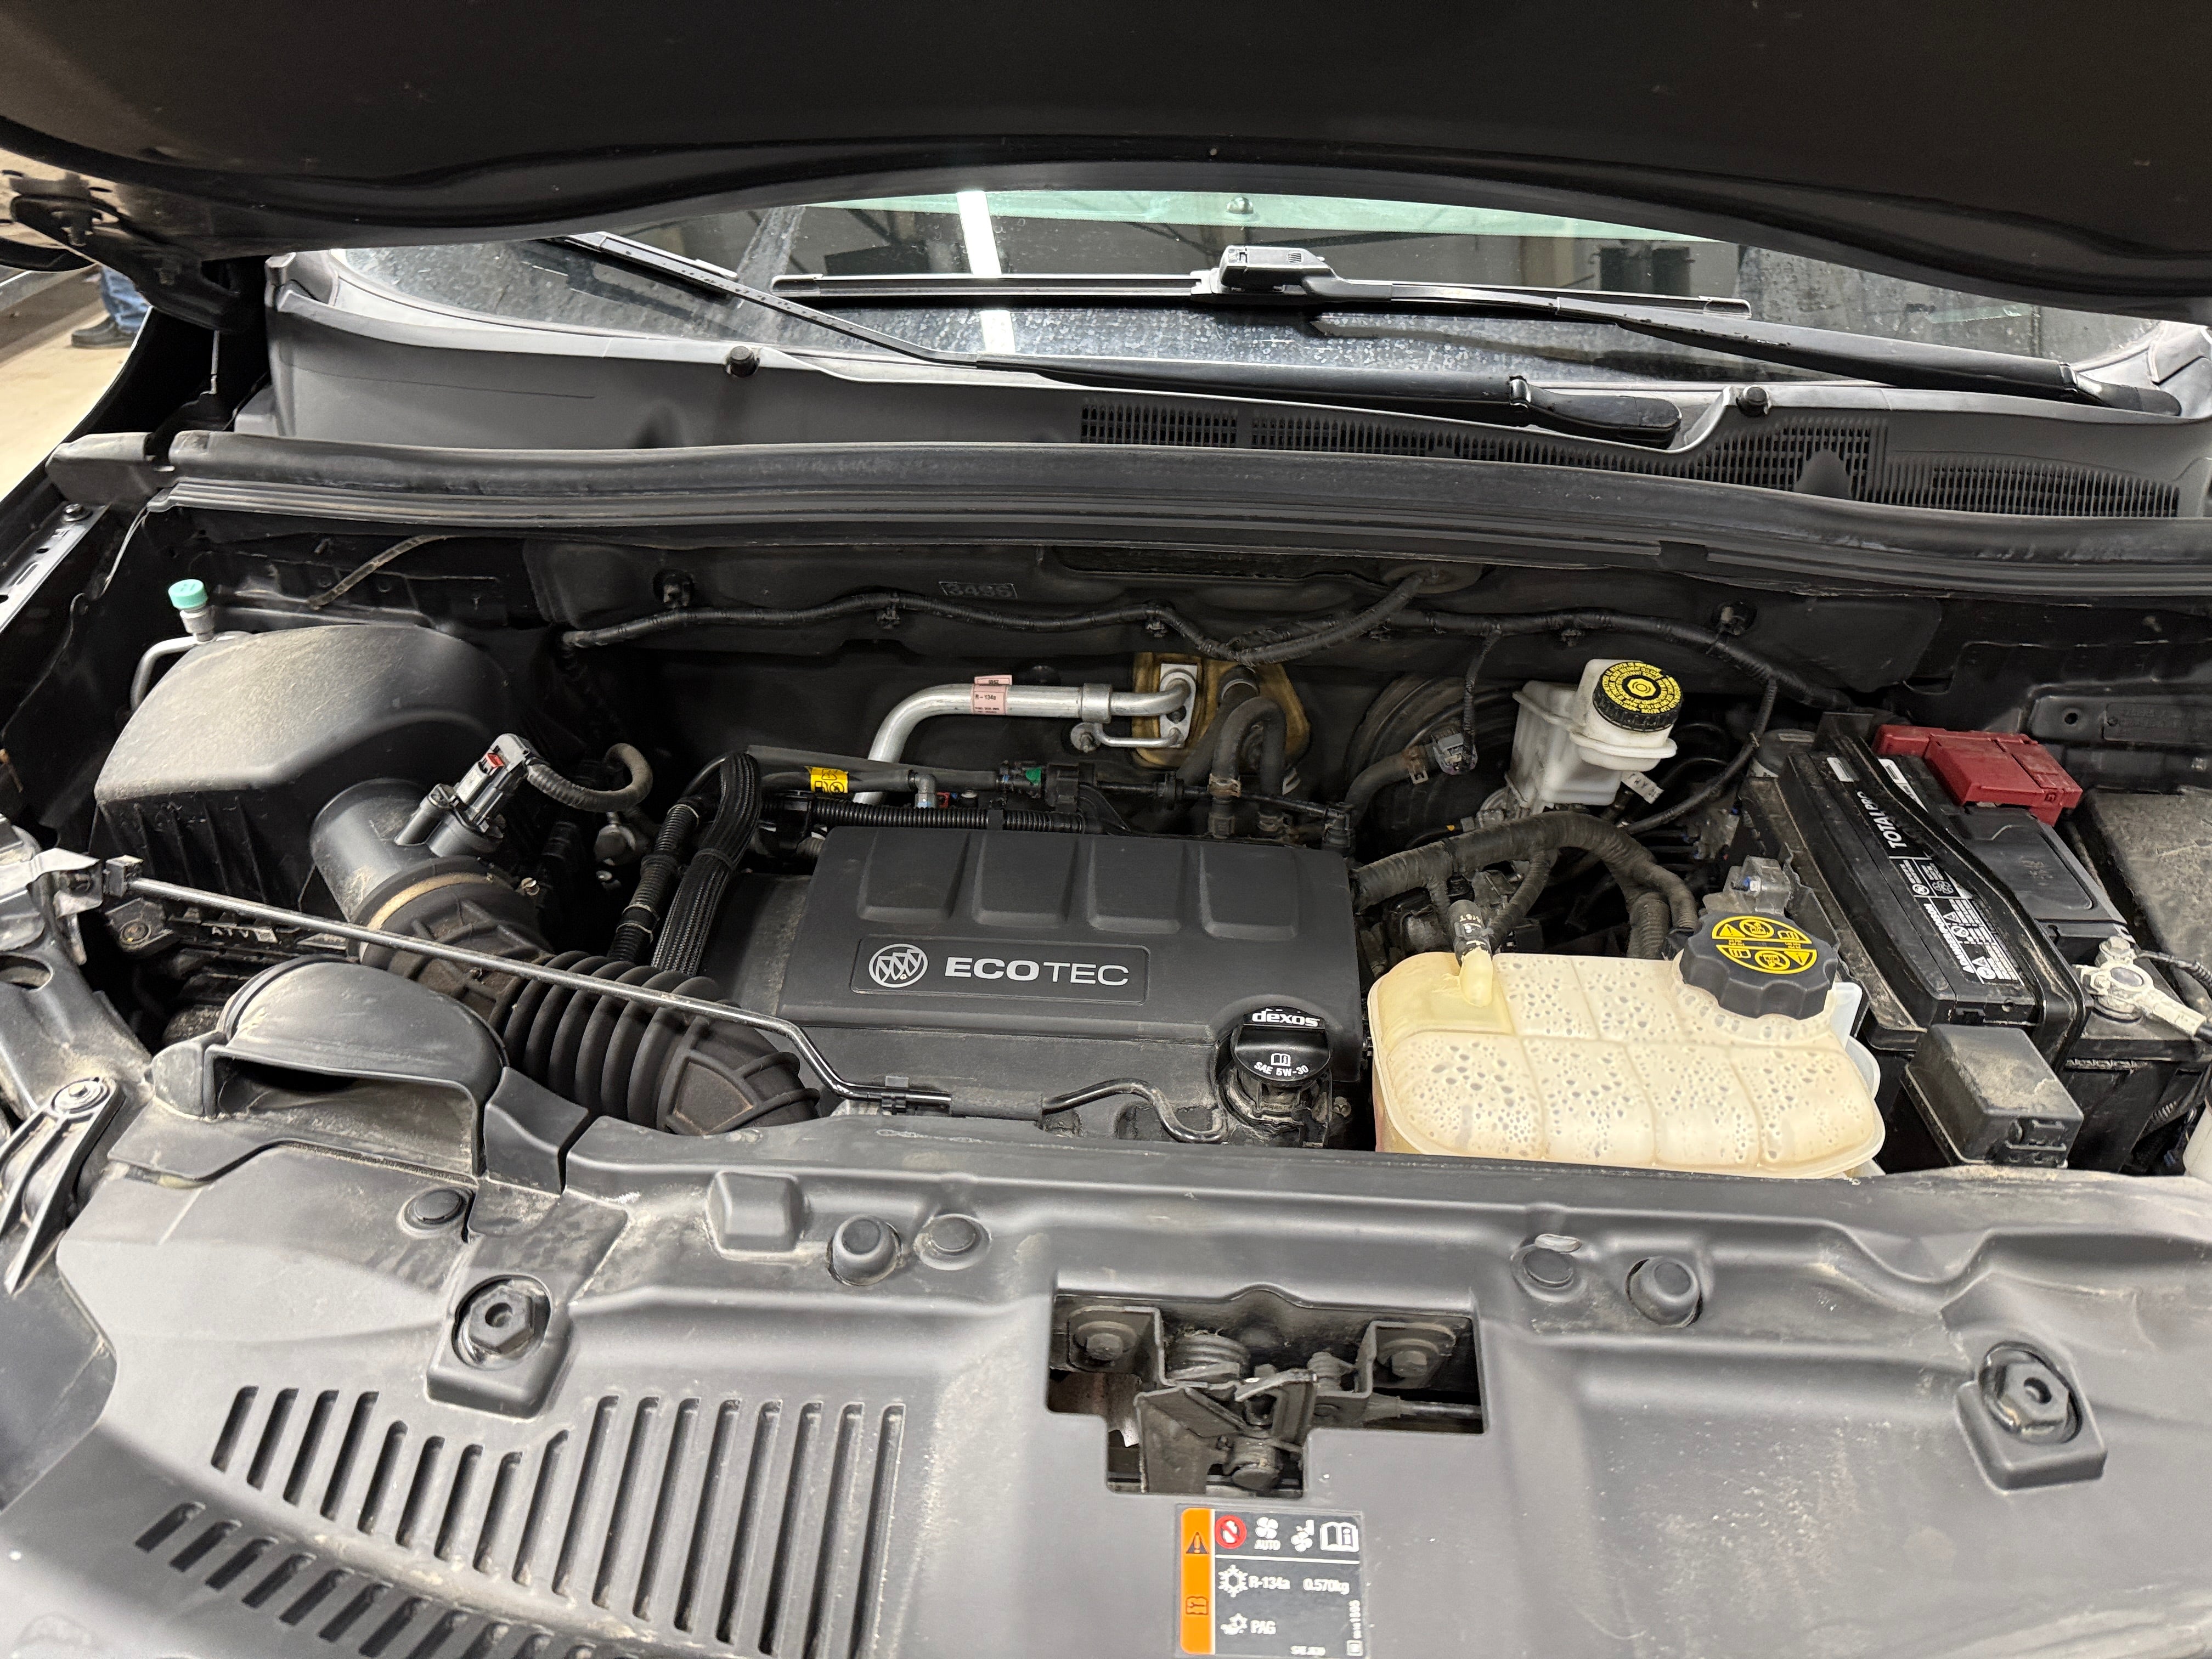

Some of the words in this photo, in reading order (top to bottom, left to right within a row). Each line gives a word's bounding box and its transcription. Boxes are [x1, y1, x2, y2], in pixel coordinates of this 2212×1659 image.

[945, 956, 1129, 986] ECOTEC
[1252, 1008, 1320, 1027] dexos
[1254, 1061, 1273, 1075] SAE
[1276, 1064, 1310, 1076] 5W-30
[1254, 1539, 1281, 1551] AUTO
[1248, 1576, 1290, 1590] R-134a
[1304, 1578, 1350, 1595] 0.570kg
[1250, 1620, 1276, 1635] PAG
